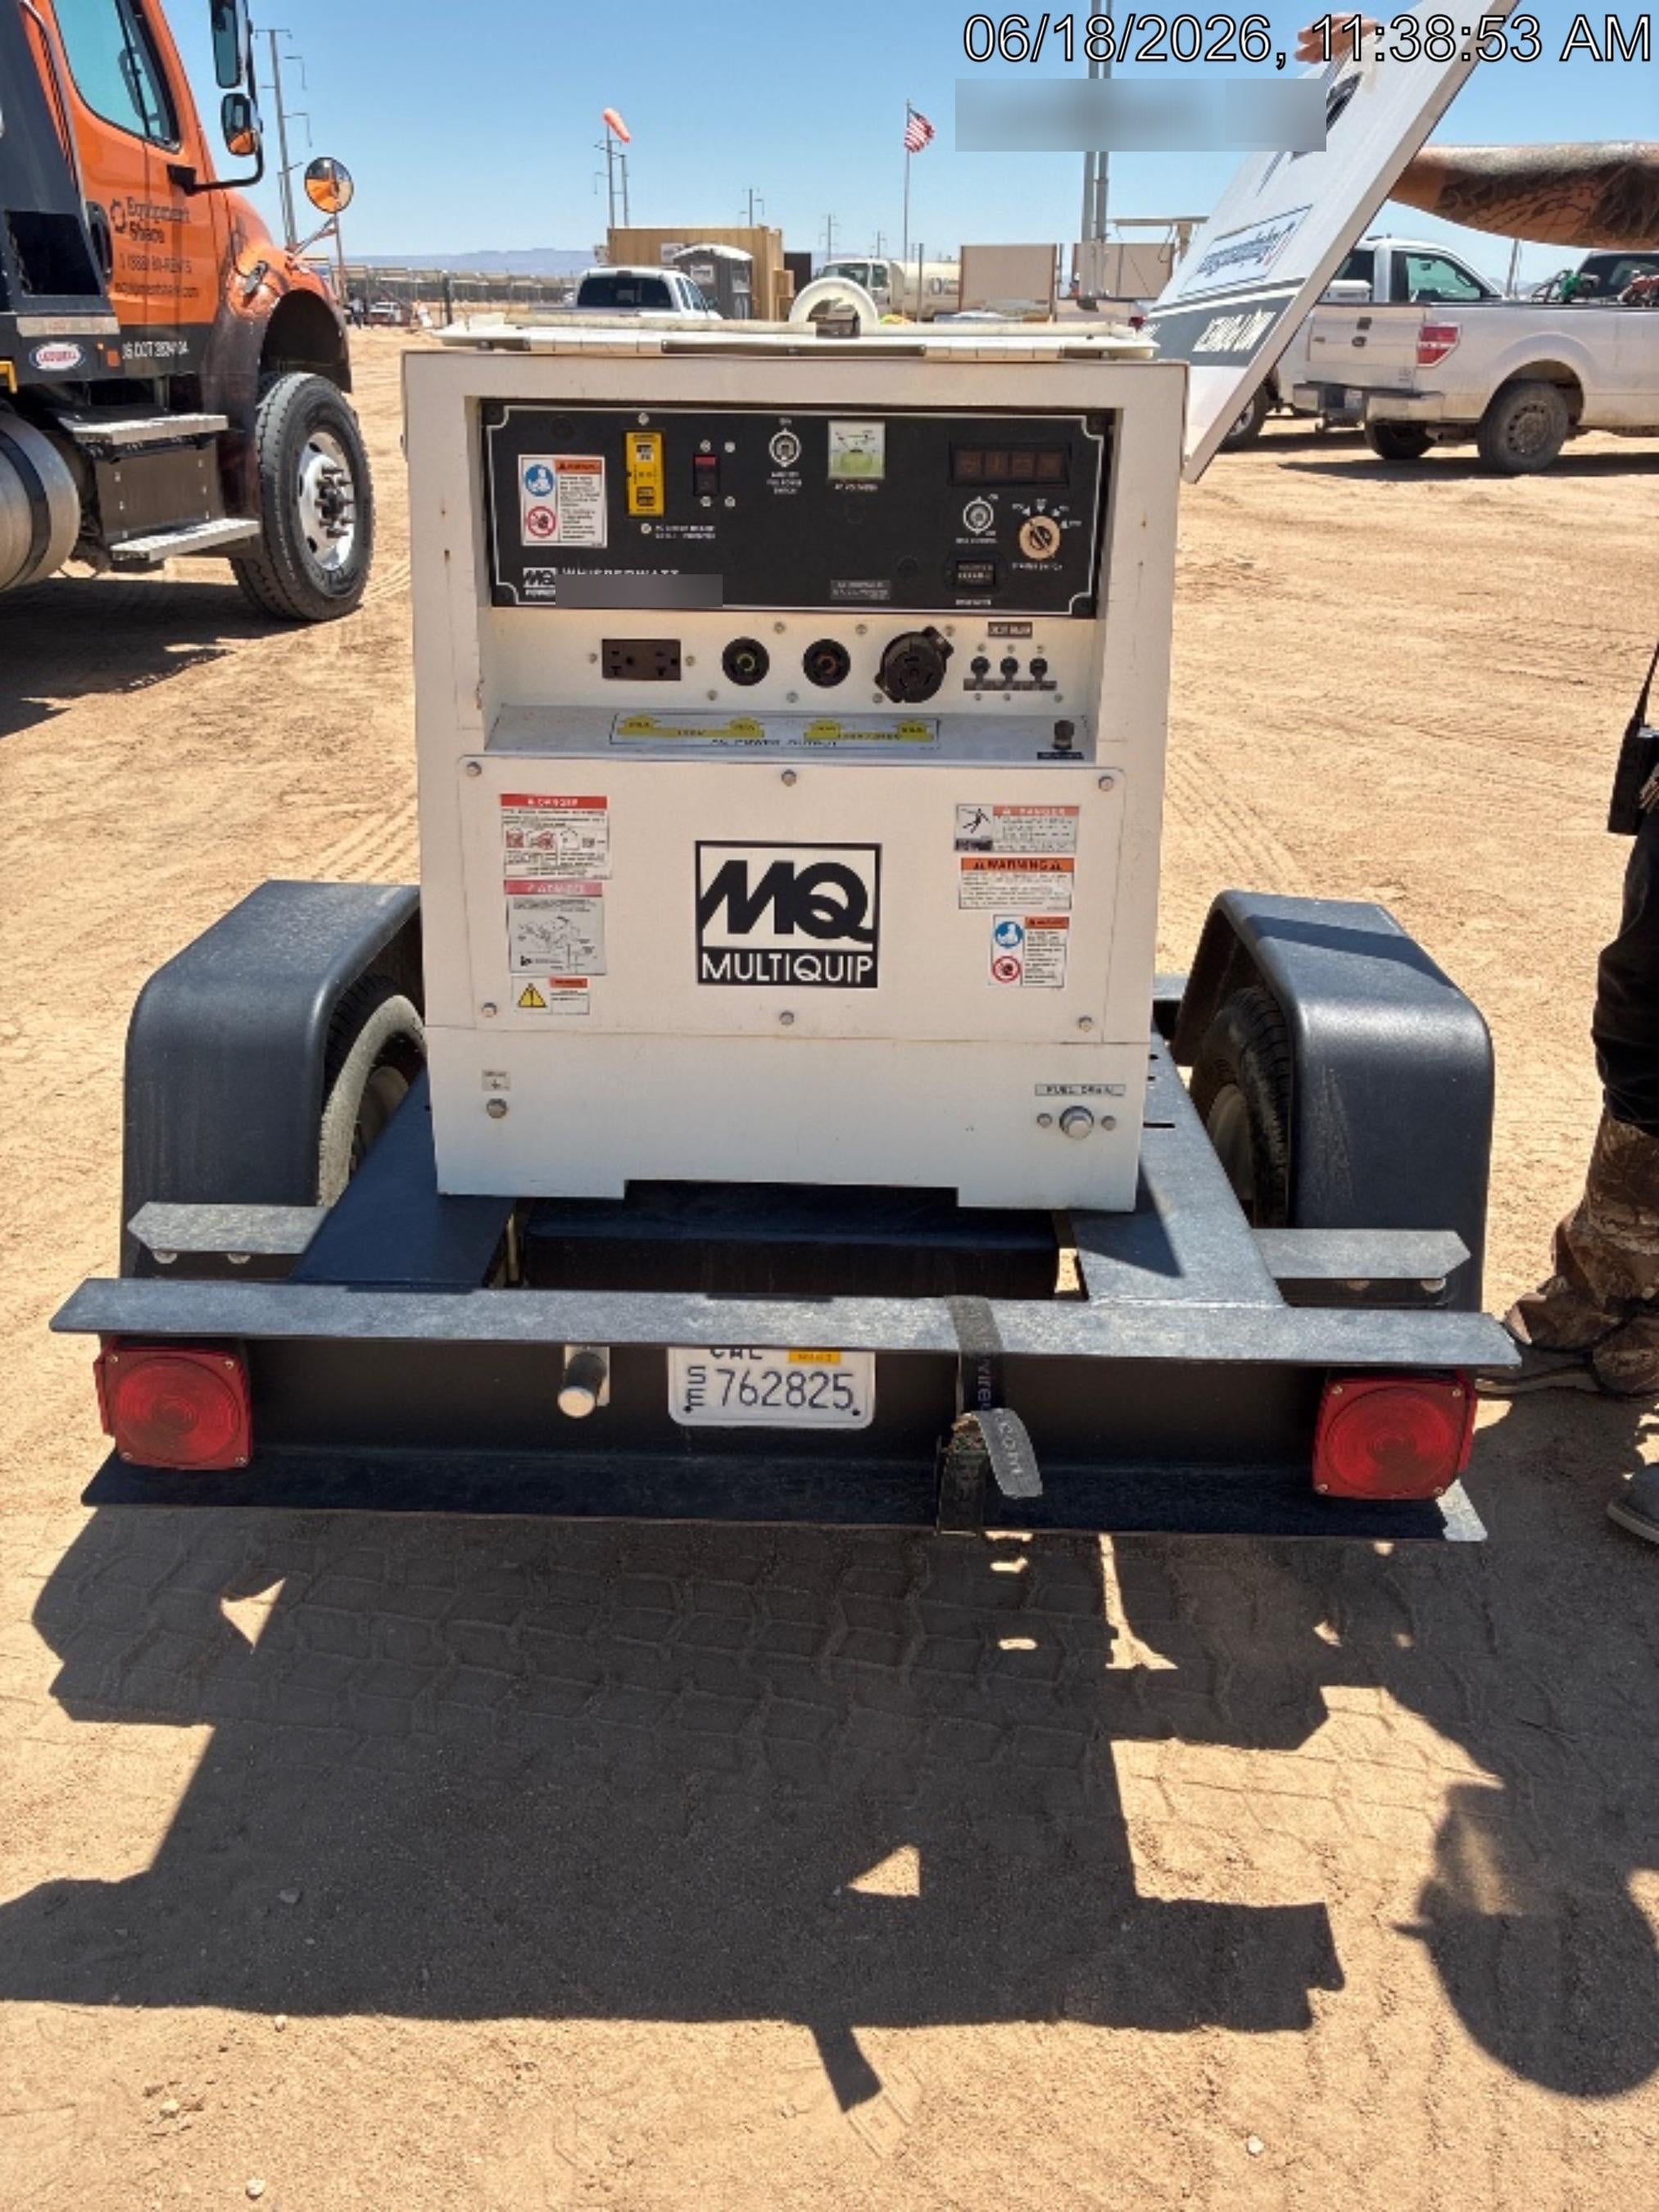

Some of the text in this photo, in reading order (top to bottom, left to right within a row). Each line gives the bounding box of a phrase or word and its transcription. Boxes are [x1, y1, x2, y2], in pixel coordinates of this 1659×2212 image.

[126, 197, 190, 224] Equipment
[987, 859, 1049, 871] WARNING
[696, 859, 875, 943] MQ
[701, 952, 874, 984] MULTIQUIP
[715, 1367, 854, 1411] 762825
